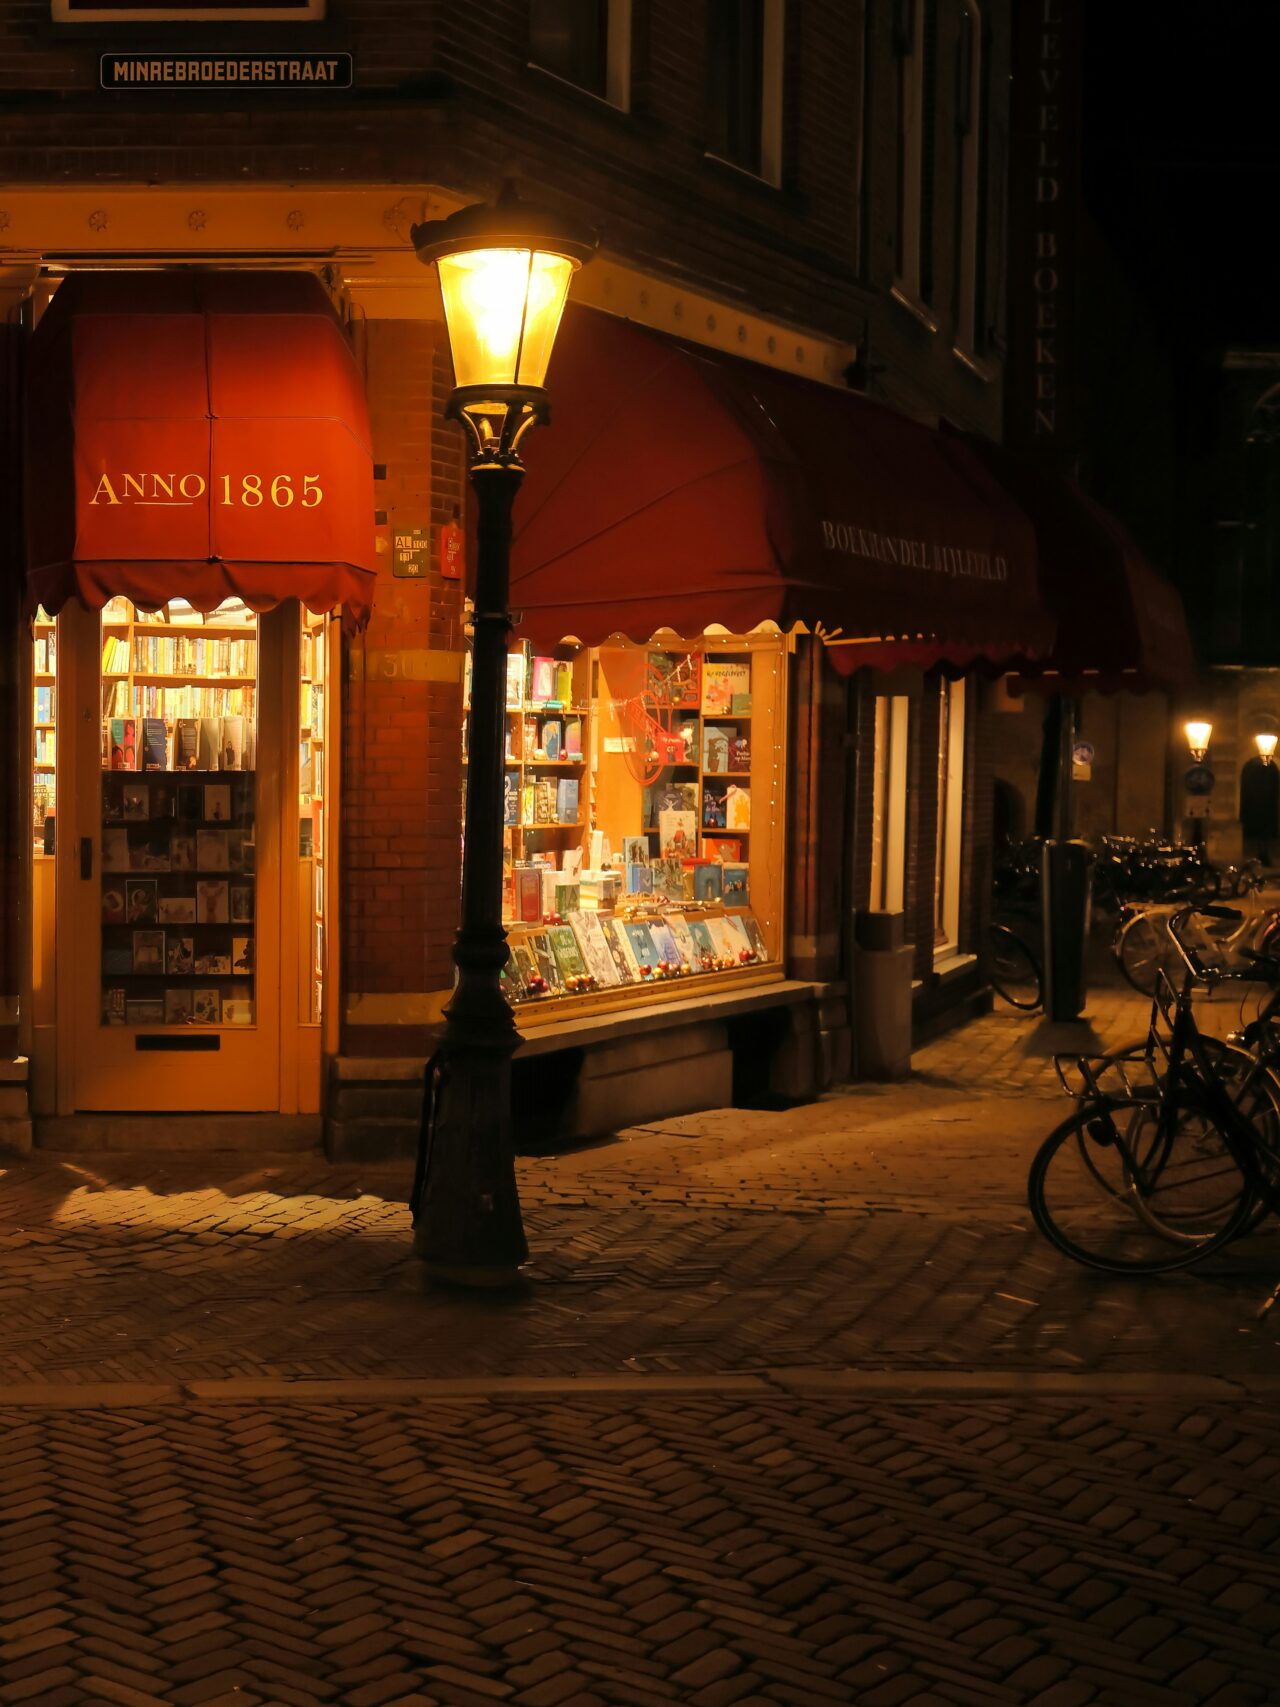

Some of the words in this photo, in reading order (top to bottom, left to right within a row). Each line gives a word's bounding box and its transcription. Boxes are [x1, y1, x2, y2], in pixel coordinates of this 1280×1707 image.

[113, 60, 339, 82] MINREBROEDERSTRAAT
[88, 473, 207, 506] ANNO
[219, 473, 324, 508] 1865
[822, 520, 931, 570] BOEKHANDEL
